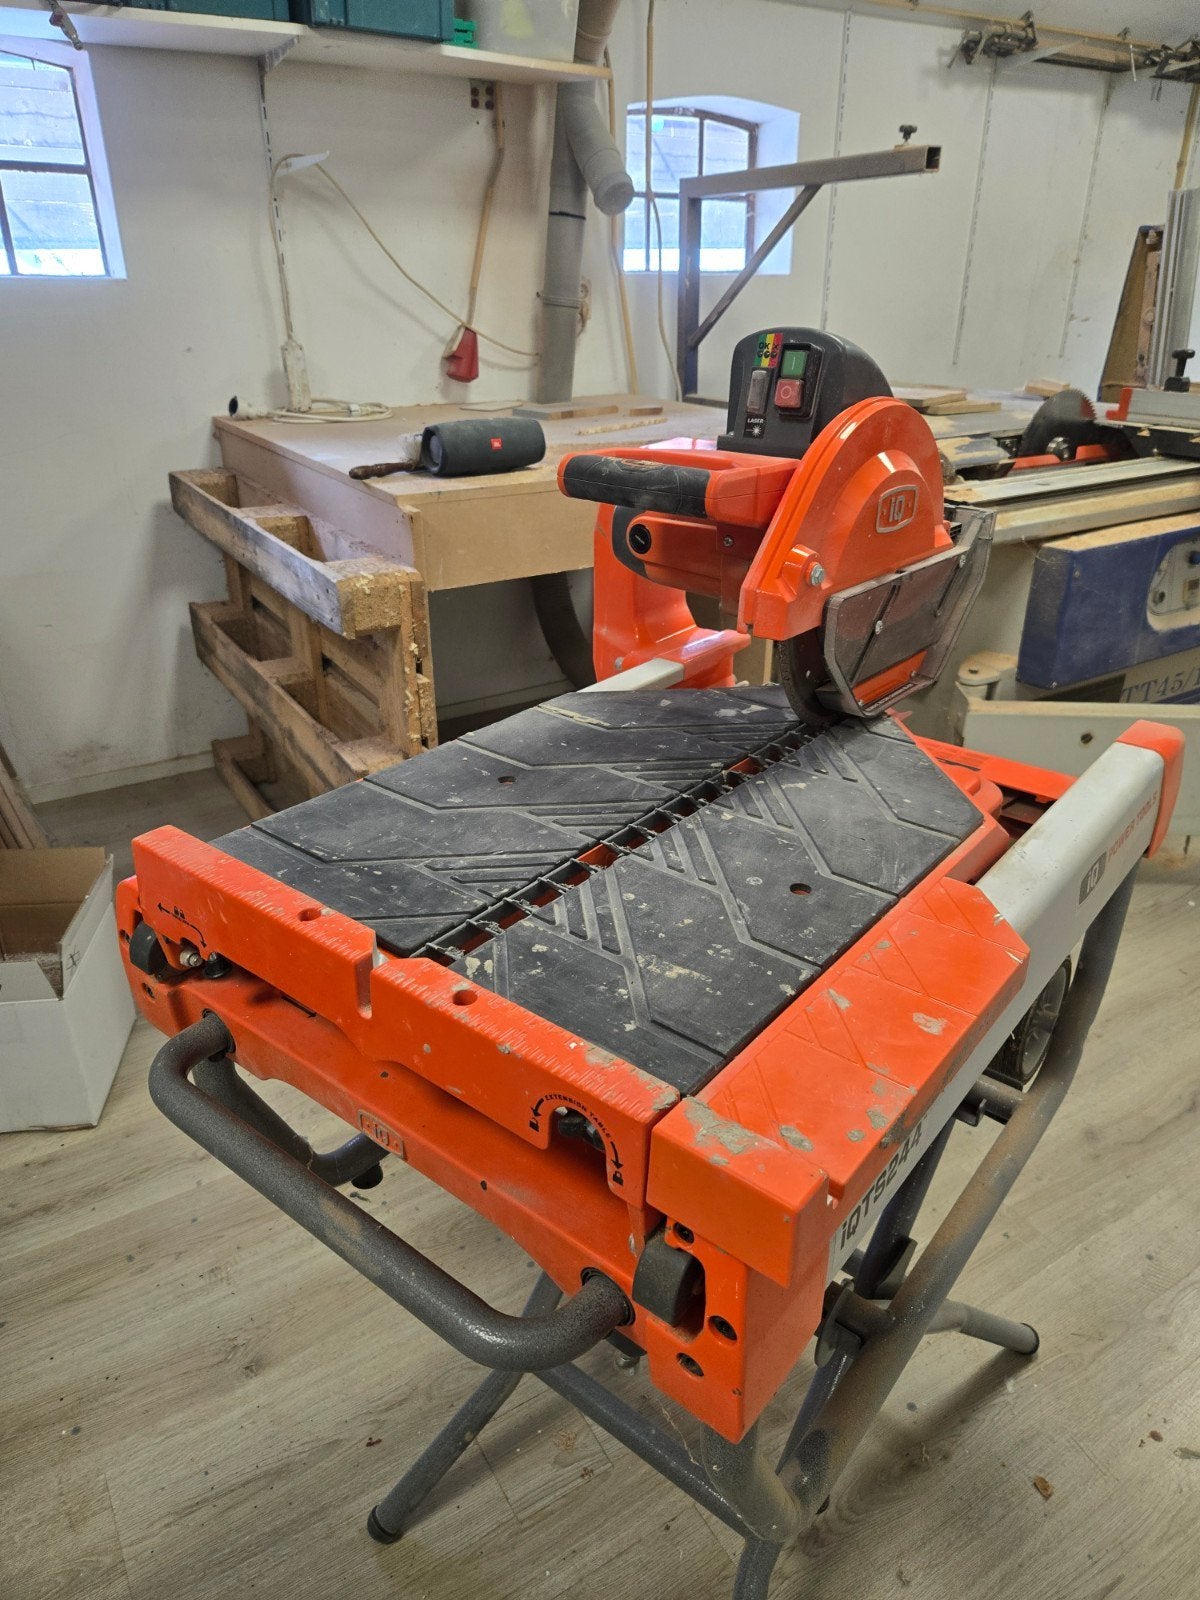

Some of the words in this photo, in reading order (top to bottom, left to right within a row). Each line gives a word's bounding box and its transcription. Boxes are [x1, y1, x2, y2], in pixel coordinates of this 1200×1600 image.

[1107, 819, 1136, 861] POWER
[544, 1094, 588, 1112] EXTENSION
[589, 1111, 612, 1139] TABLE
[840, 1122, 923, 1250] iQTS244
